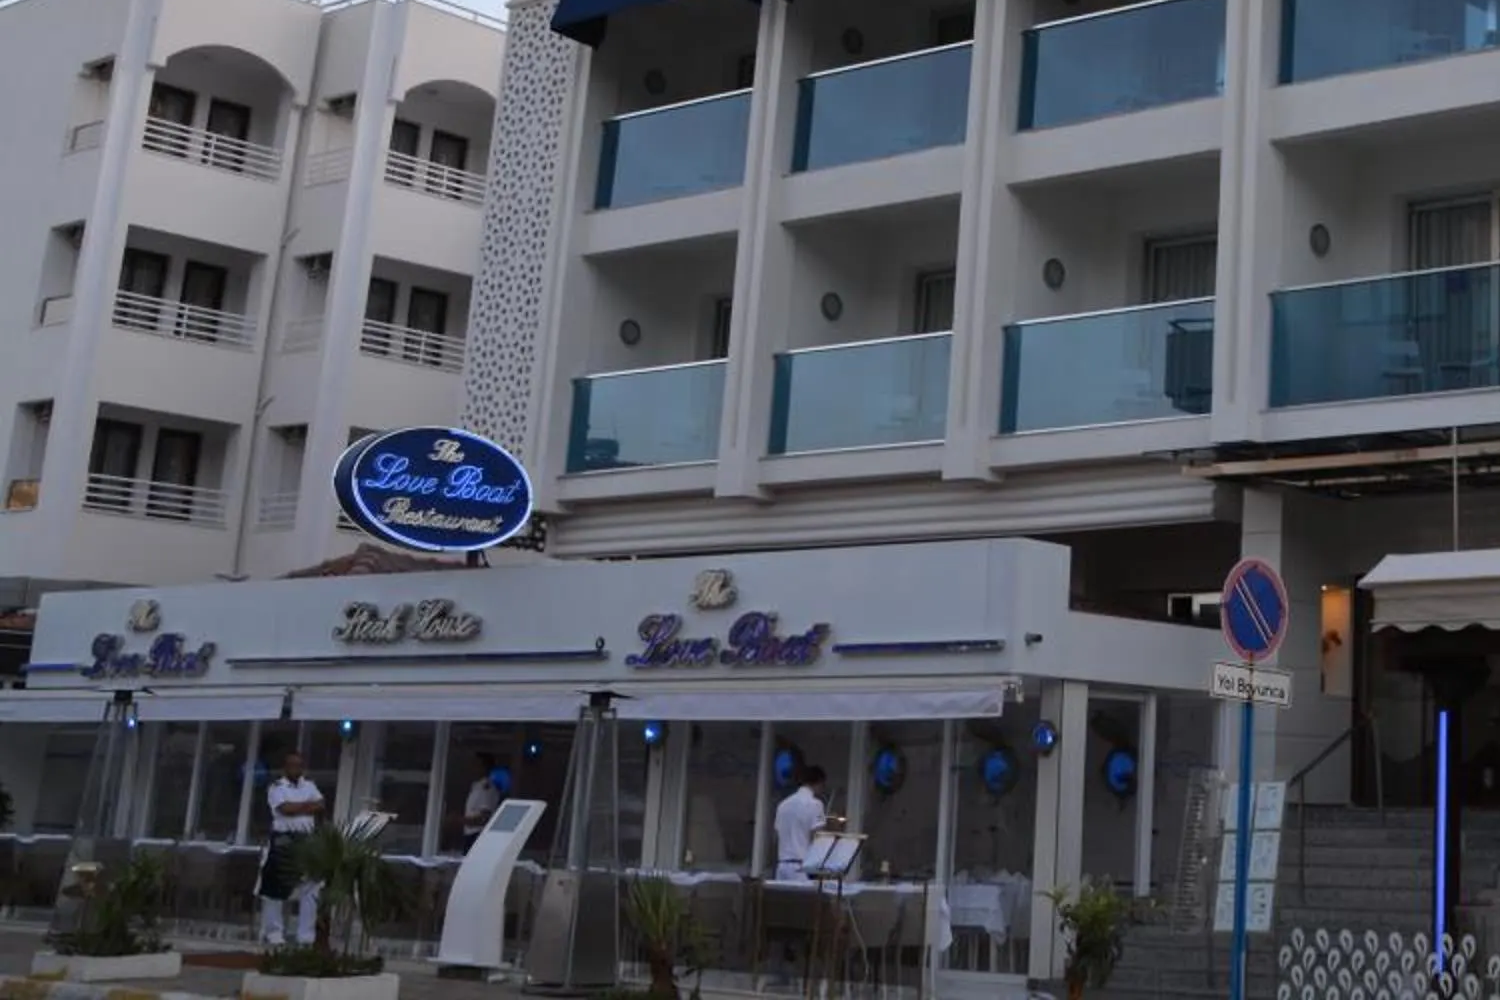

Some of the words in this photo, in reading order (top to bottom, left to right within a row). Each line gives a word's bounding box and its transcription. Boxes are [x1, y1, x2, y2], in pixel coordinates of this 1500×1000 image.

[428, 439, 466, 463] The
[364, 453, 440, 494] Love
[443, 465, 523, 503] Boat
[378, 497, 504, 533] Restaurant
[688, 569, 738, 610] The
[331, 601, 414, 643] Steak
[411, 598, 484, 643] House
[624, 613, 719, 668] Love
[719, 611, 831, 667] Boat
[1217, 674, 1236, 692] Yol
[1237, 677, 1286, 699] Boyunca
